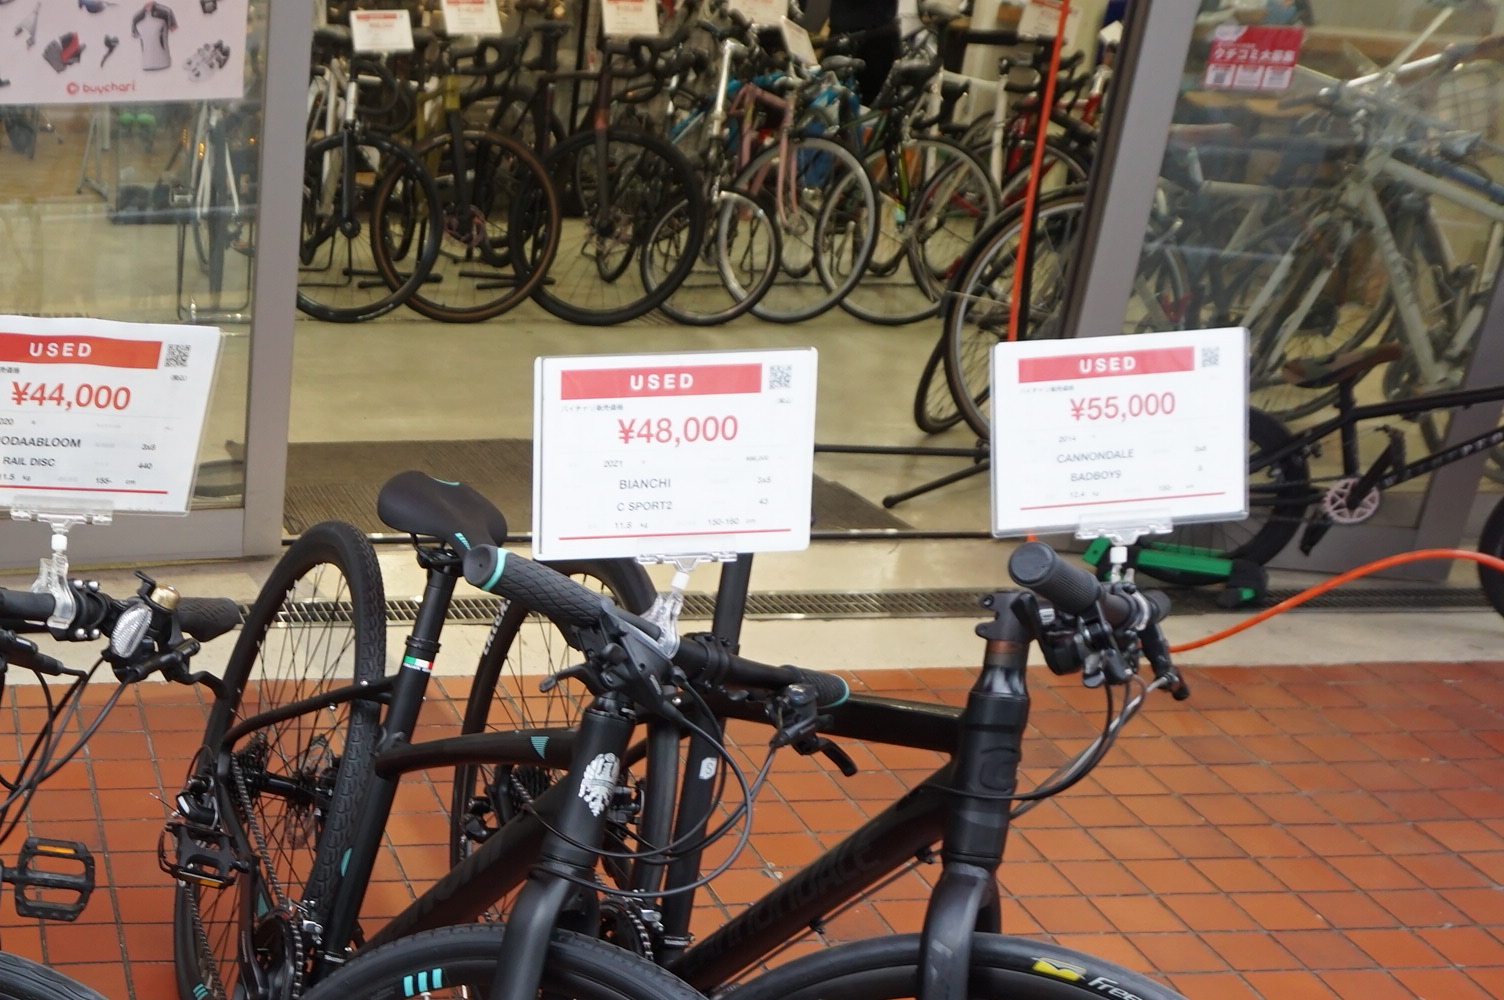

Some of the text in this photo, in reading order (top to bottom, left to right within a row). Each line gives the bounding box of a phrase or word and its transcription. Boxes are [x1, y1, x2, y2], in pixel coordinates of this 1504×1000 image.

[28, 342, 93, 358] USED
[1079, 356, 1137, 374] USED
[629, 373, 695, 391] USED
[10, 381, 132, 412] ¥44,000
[1069, 392, 1177, 422] ¥55,000
[617, 415, 739, 448] ¥48,000
[2, 456, 56, 467] RAIL DISC
[1056, 448, 1135, 464] CANNONDALE
[618, 478, 672, 490] BIANCHI
[616, 500, 673, 513] C SPORT2
